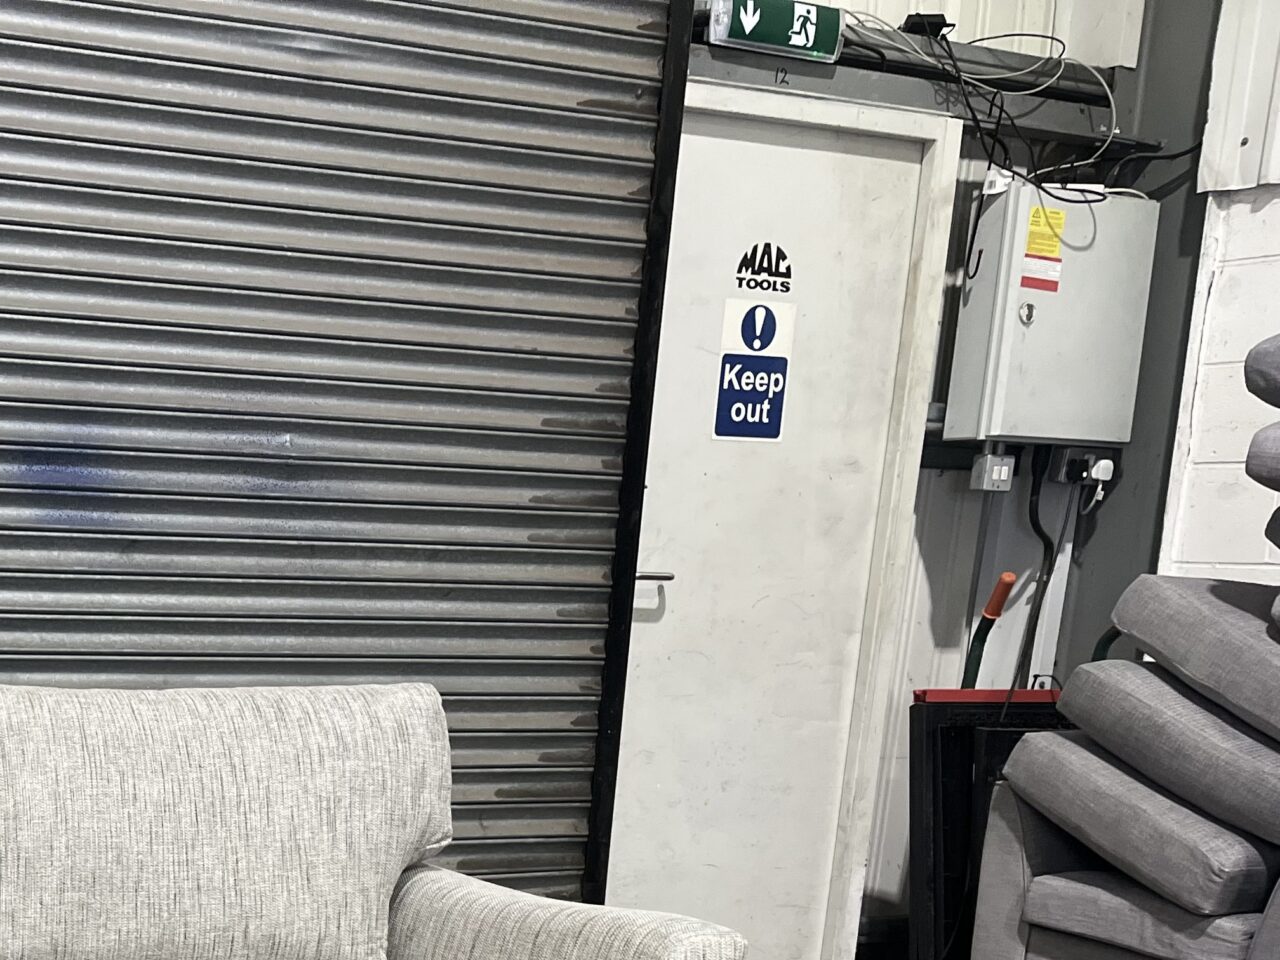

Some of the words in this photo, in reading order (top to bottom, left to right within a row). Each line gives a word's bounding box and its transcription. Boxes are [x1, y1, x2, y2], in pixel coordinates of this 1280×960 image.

[775, 67, 790, 86] 12
[736, 242, 792, 279] MAC
[736, 276, 791, 293] TOOLS
[722, 363, 784, 398] Keep
[730, 398, 771, 423] out
